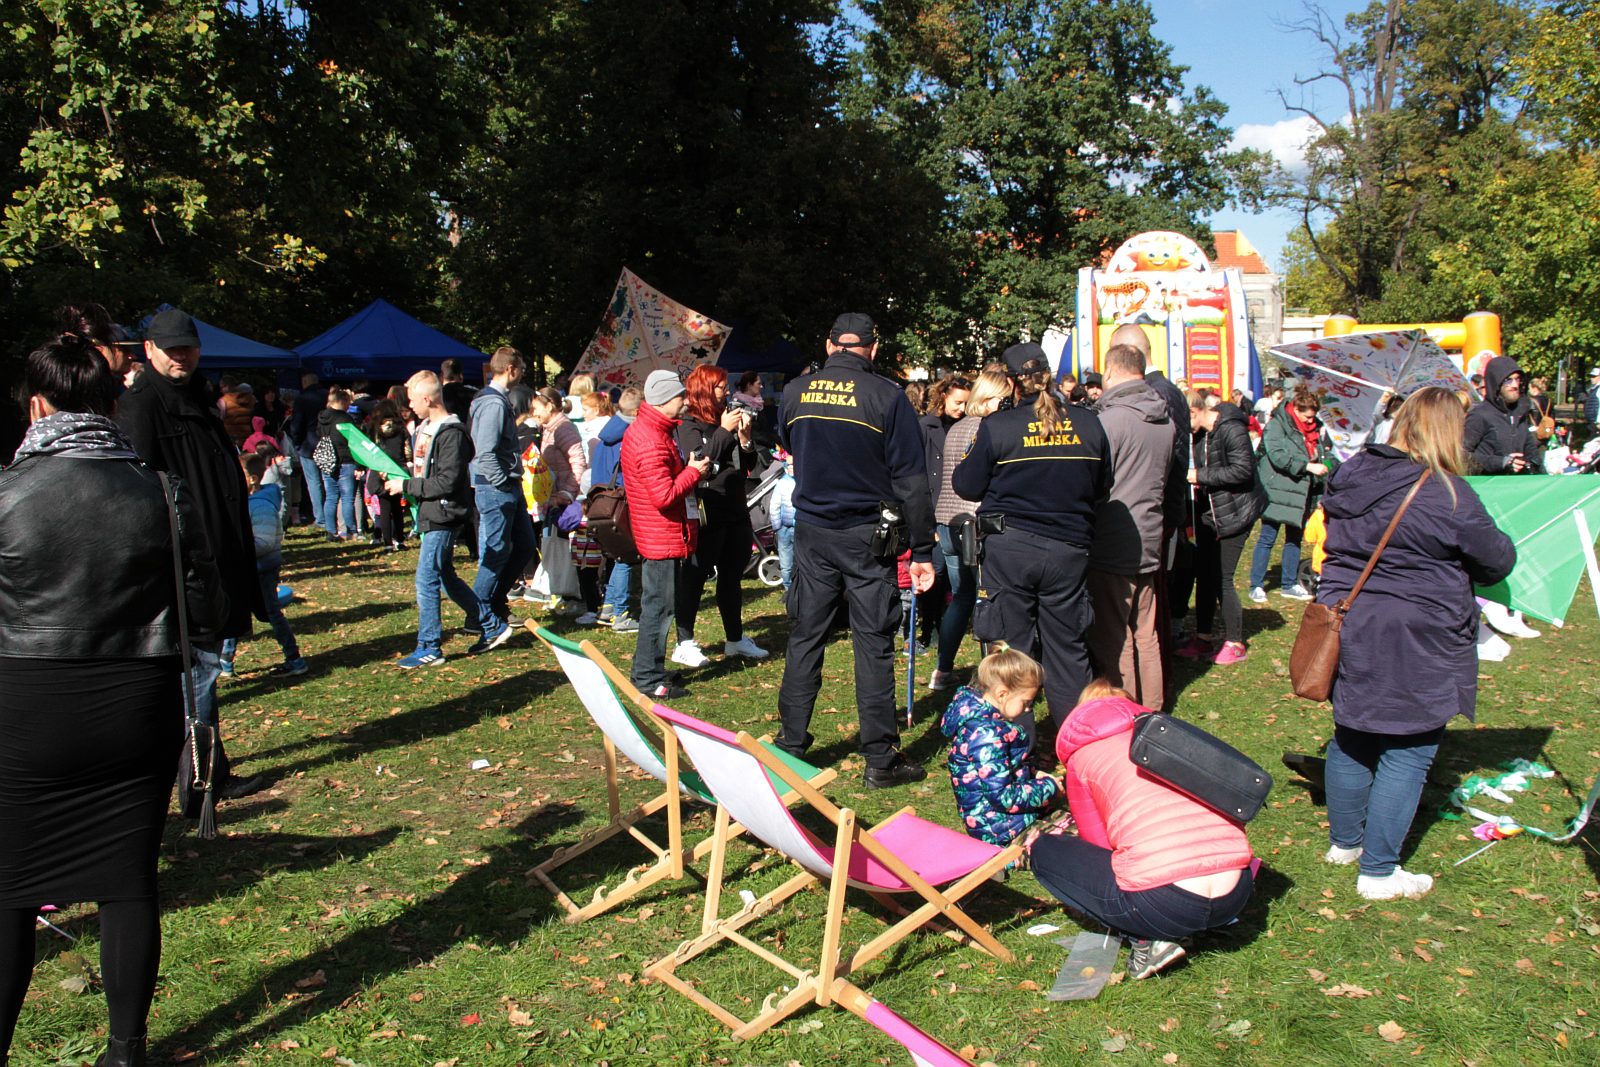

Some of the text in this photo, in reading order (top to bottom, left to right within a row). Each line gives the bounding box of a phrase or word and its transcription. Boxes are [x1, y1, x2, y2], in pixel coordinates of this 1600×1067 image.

[808, 380, 855, 393] STRAŻ
[800, 392, 857, 407] MIEJSKA
[1027, 418, 1073, 433] STAŻ
